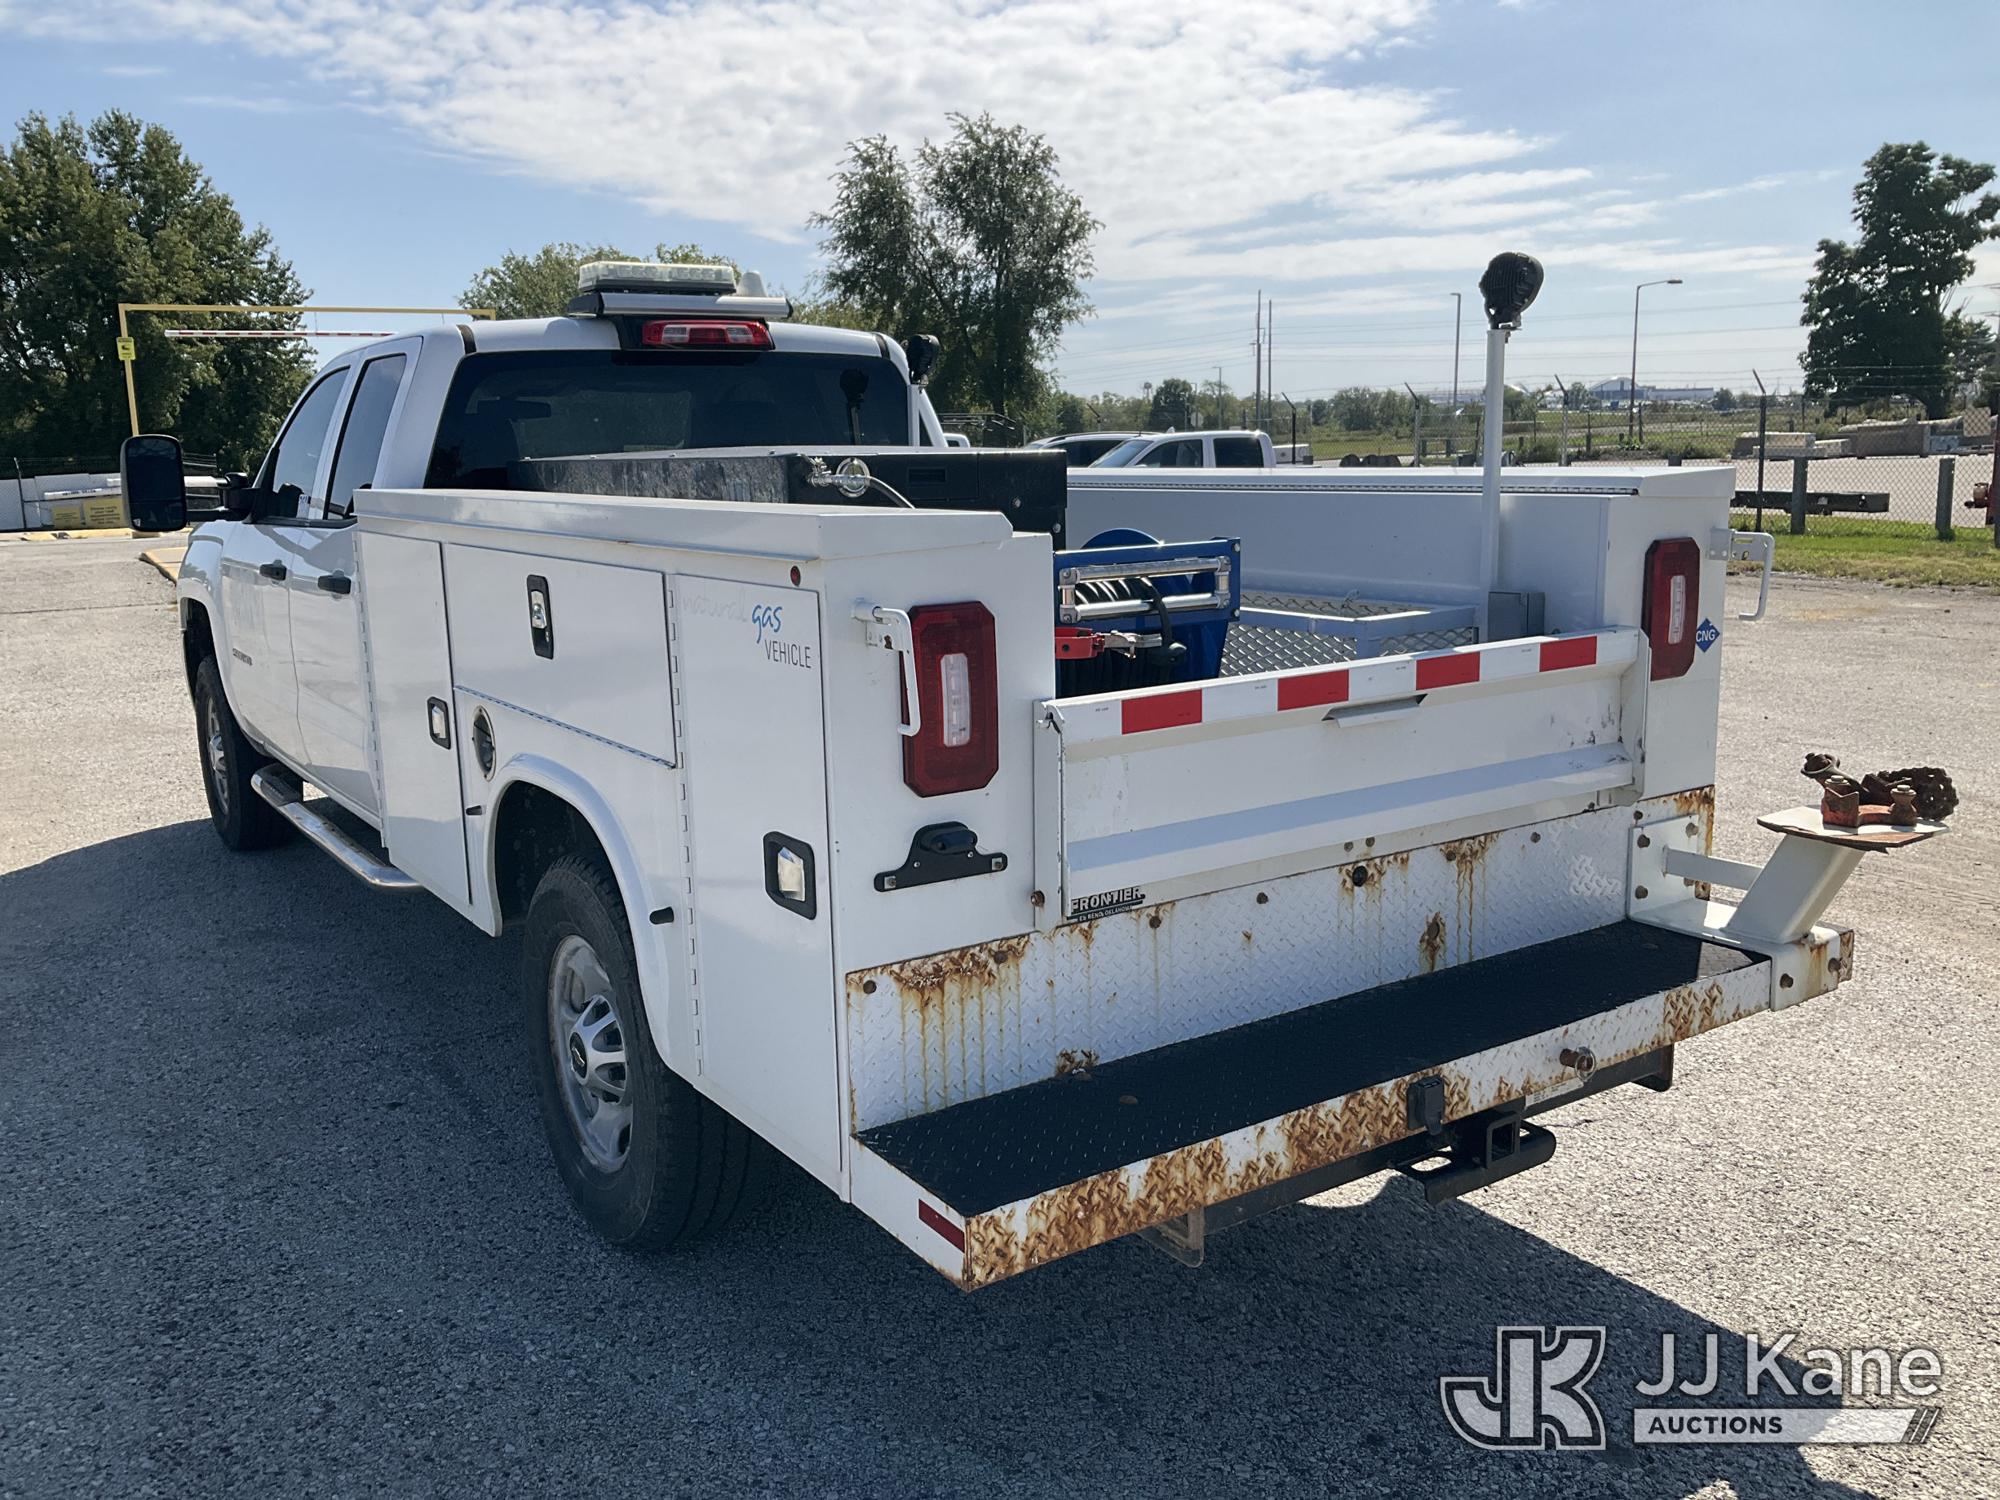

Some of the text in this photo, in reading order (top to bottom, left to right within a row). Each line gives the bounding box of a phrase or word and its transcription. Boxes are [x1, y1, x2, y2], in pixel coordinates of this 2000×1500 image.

[752, 604, 783, 643] gas
[1696, 629, 1716, 642] CNG
[764, 639, 812, 669] VEHICLE
[1071, 886, 1142, 911] FRONTIER
